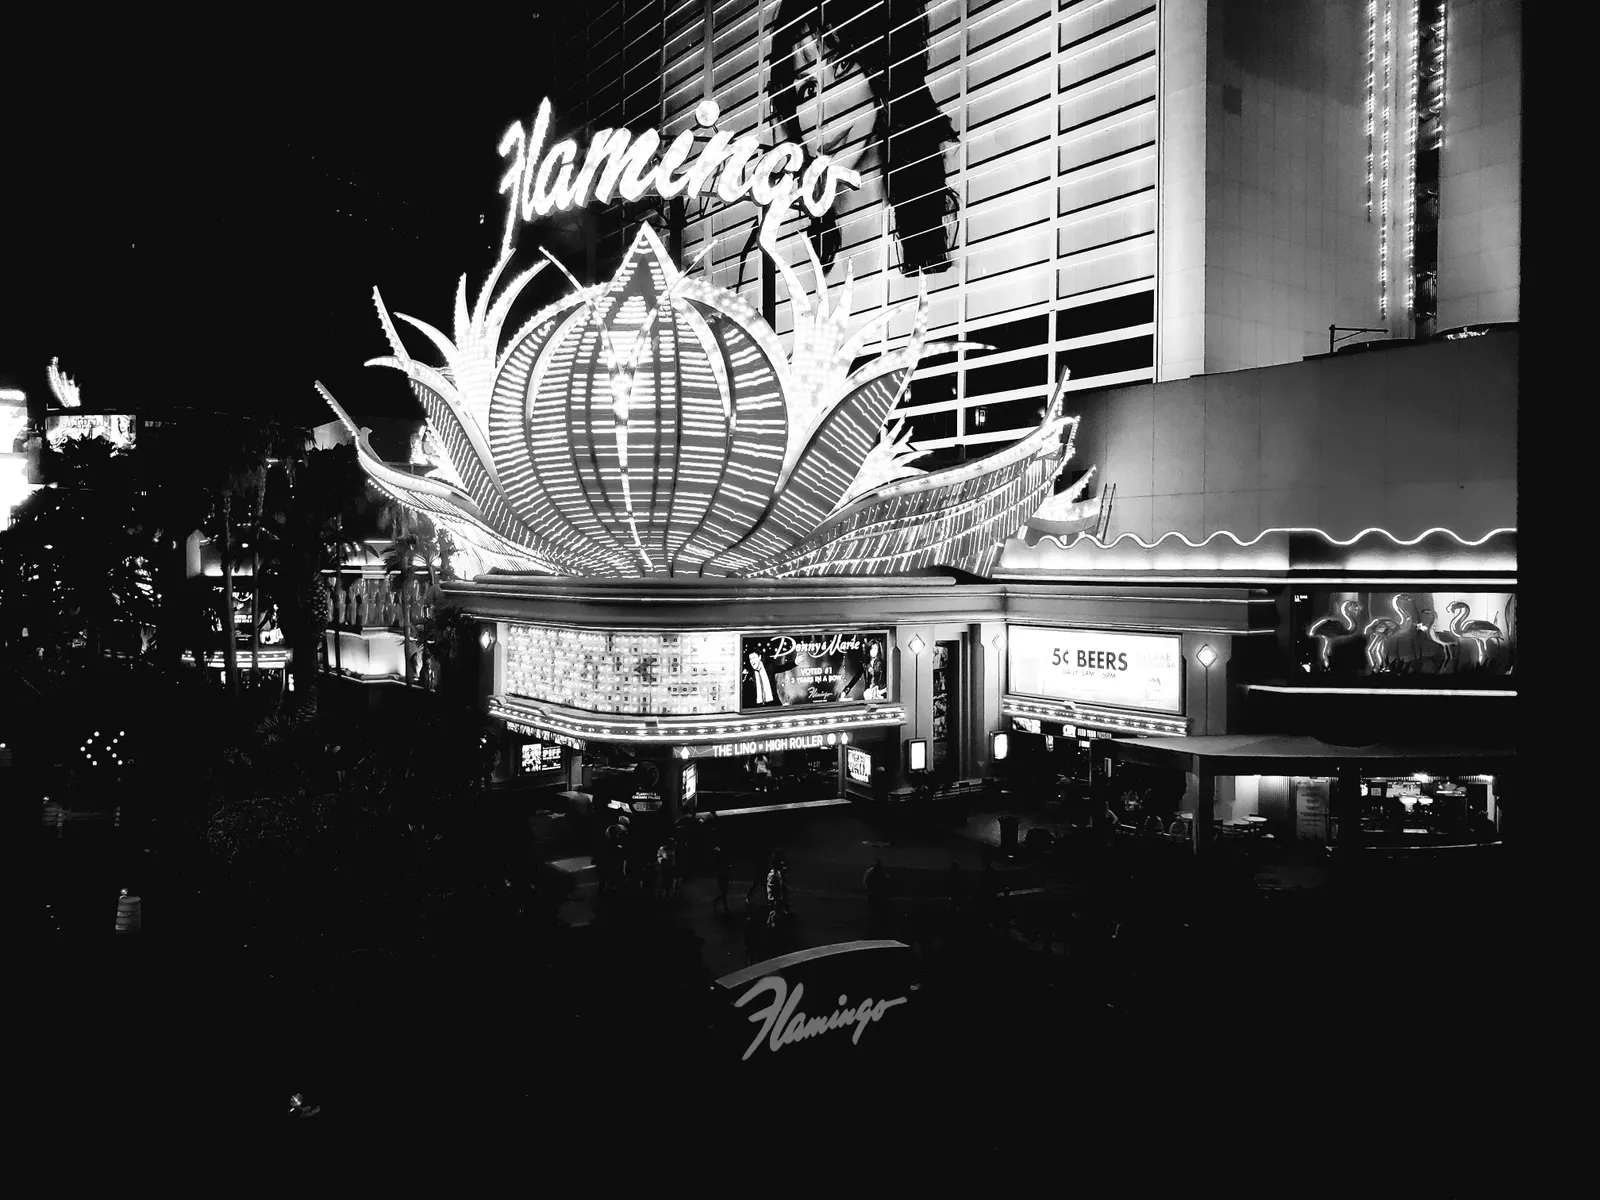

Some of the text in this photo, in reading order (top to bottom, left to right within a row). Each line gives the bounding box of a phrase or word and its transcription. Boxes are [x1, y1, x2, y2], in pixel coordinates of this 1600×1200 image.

[498, 96, 862, 254] Flamingo
[769, 635, 821, 660] Donny
[815, 633, 861, 658] Marie
[800, 667, 823, 676] VOTED
[1052, 648, 1070, 666] 5¢
[1077, 649, 1128, 672] BEERS
[796, 676, 814, 684] YEARS
[542, 748, 561, 759] PIFF
[712, 744, 733, 758] THE
[765, 738, 788, 752] HIGH
[789, 734, 824, 750] ROLLER
[733, 975, 908, 1061] Flamingo
